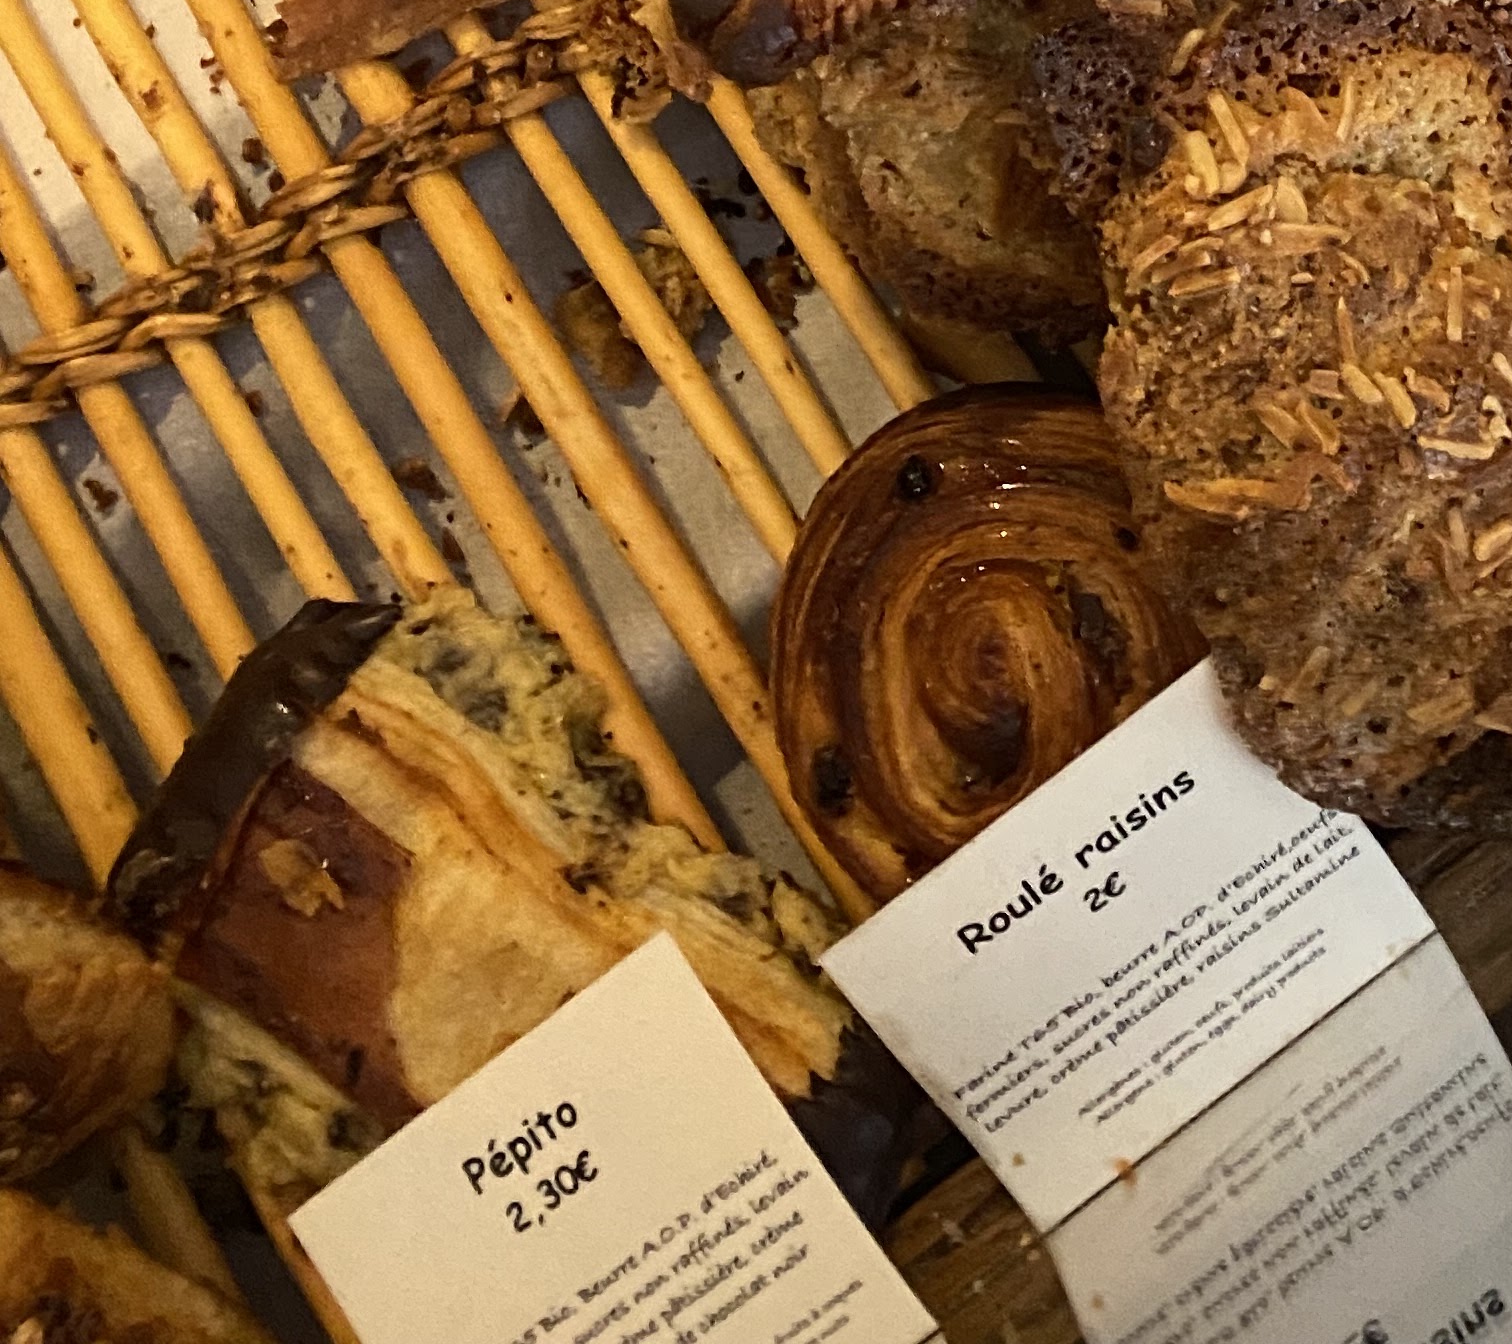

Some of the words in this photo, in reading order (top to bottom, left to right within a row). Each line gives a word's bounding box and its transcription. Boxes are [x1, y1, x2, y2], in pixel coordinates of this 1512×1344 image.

[956, 863, 1064, 955] Roulé
[1074, 770, 1195, 869] raisins
[1083, 871, 1126, 912] 2€
[1052, 1008, 1111, 1055] sucres
[1113, 978, 1151, 1009] non
[1231, 874, 1290, 916] levain
[1292, 853, 1313, 873] de
[1100, 943, 1159, 988] beurre
[1195, 921, 1262, 973] raisins
[461, 1102, 577, 1195] Pépito
[505, 1149, 598, 1233] 2,30€
